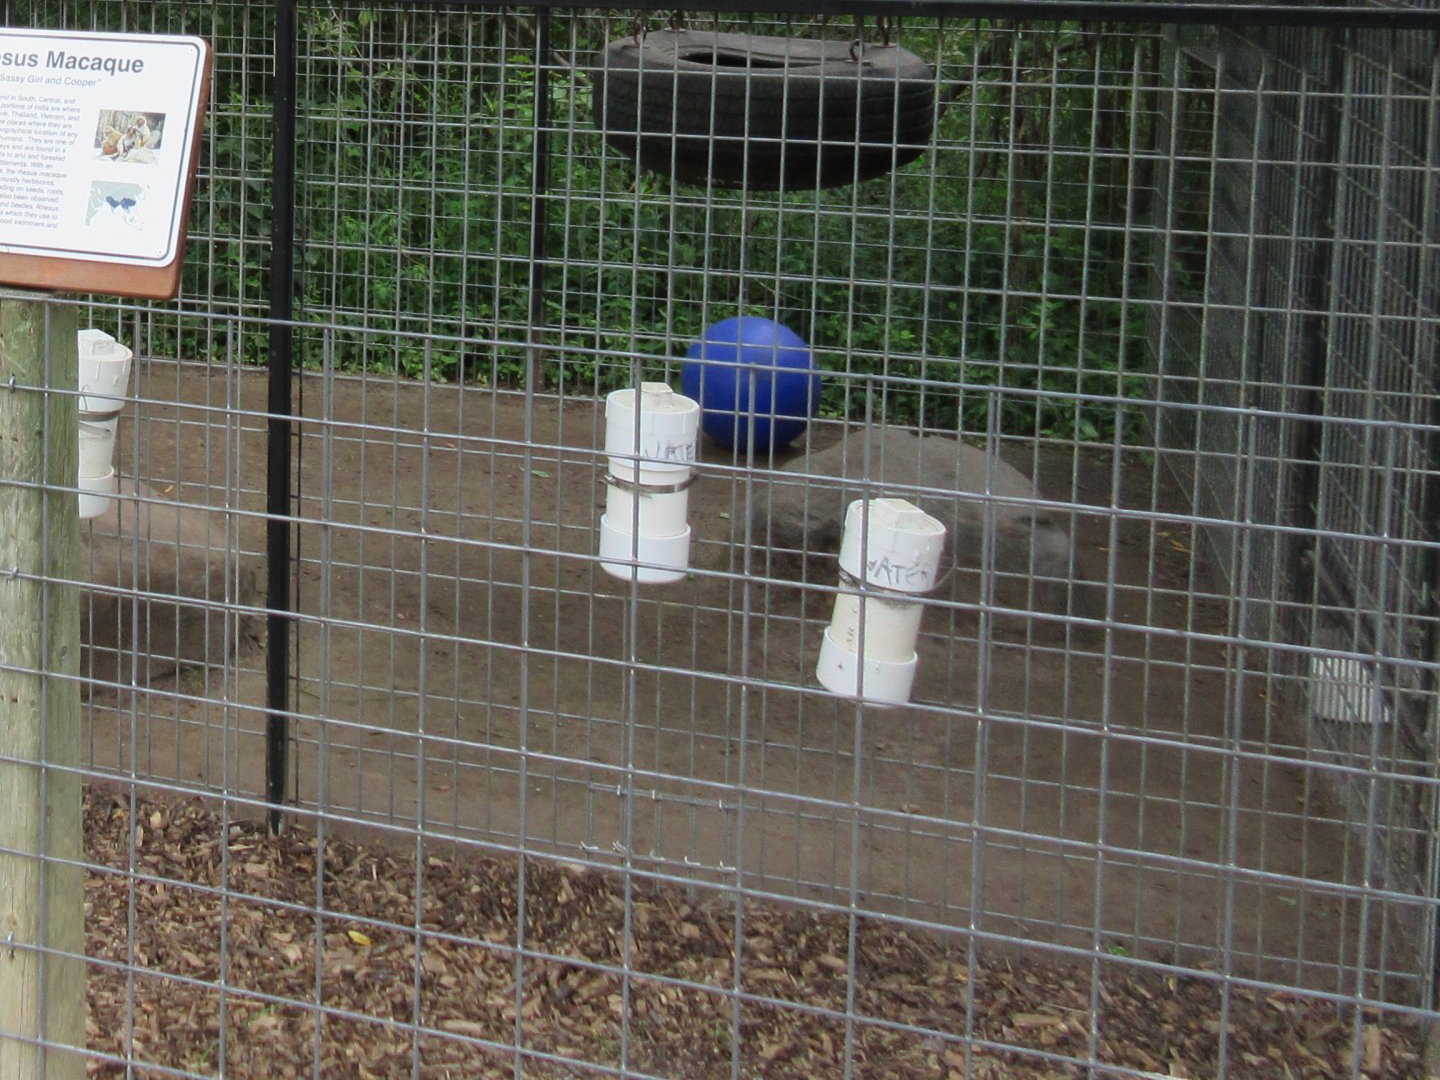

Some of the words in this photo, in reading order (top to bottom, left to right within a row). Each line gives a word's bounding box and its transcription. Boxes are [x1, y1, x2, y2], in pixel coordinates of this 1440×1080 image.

[46, 50, 144, 76] Macaque
[27, 74, 42, 84] Girl
[44, 75, 62, 85] and
